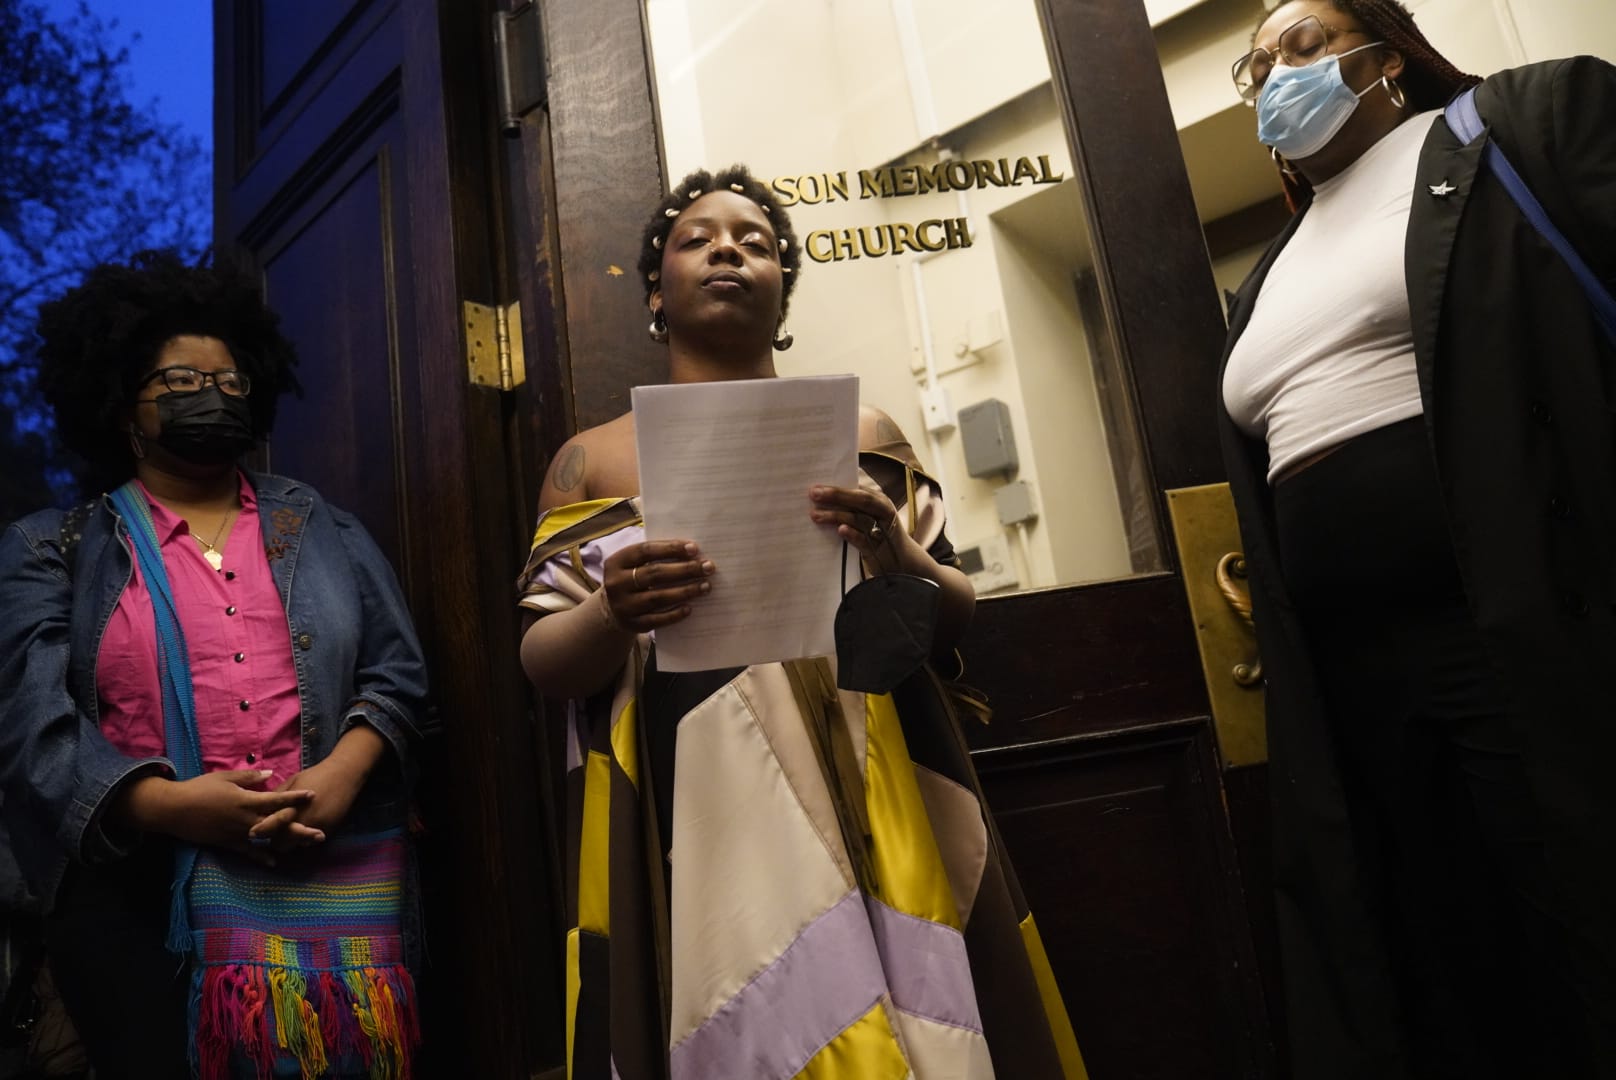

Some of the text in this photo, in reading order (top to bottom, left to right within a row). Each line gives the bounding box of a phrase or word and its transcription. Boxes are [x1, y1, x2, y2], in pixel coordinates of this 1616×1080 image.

[758, 155, 1064, 206] SON MEMORIAL
[805, 217, 973, 263] CHURCH
